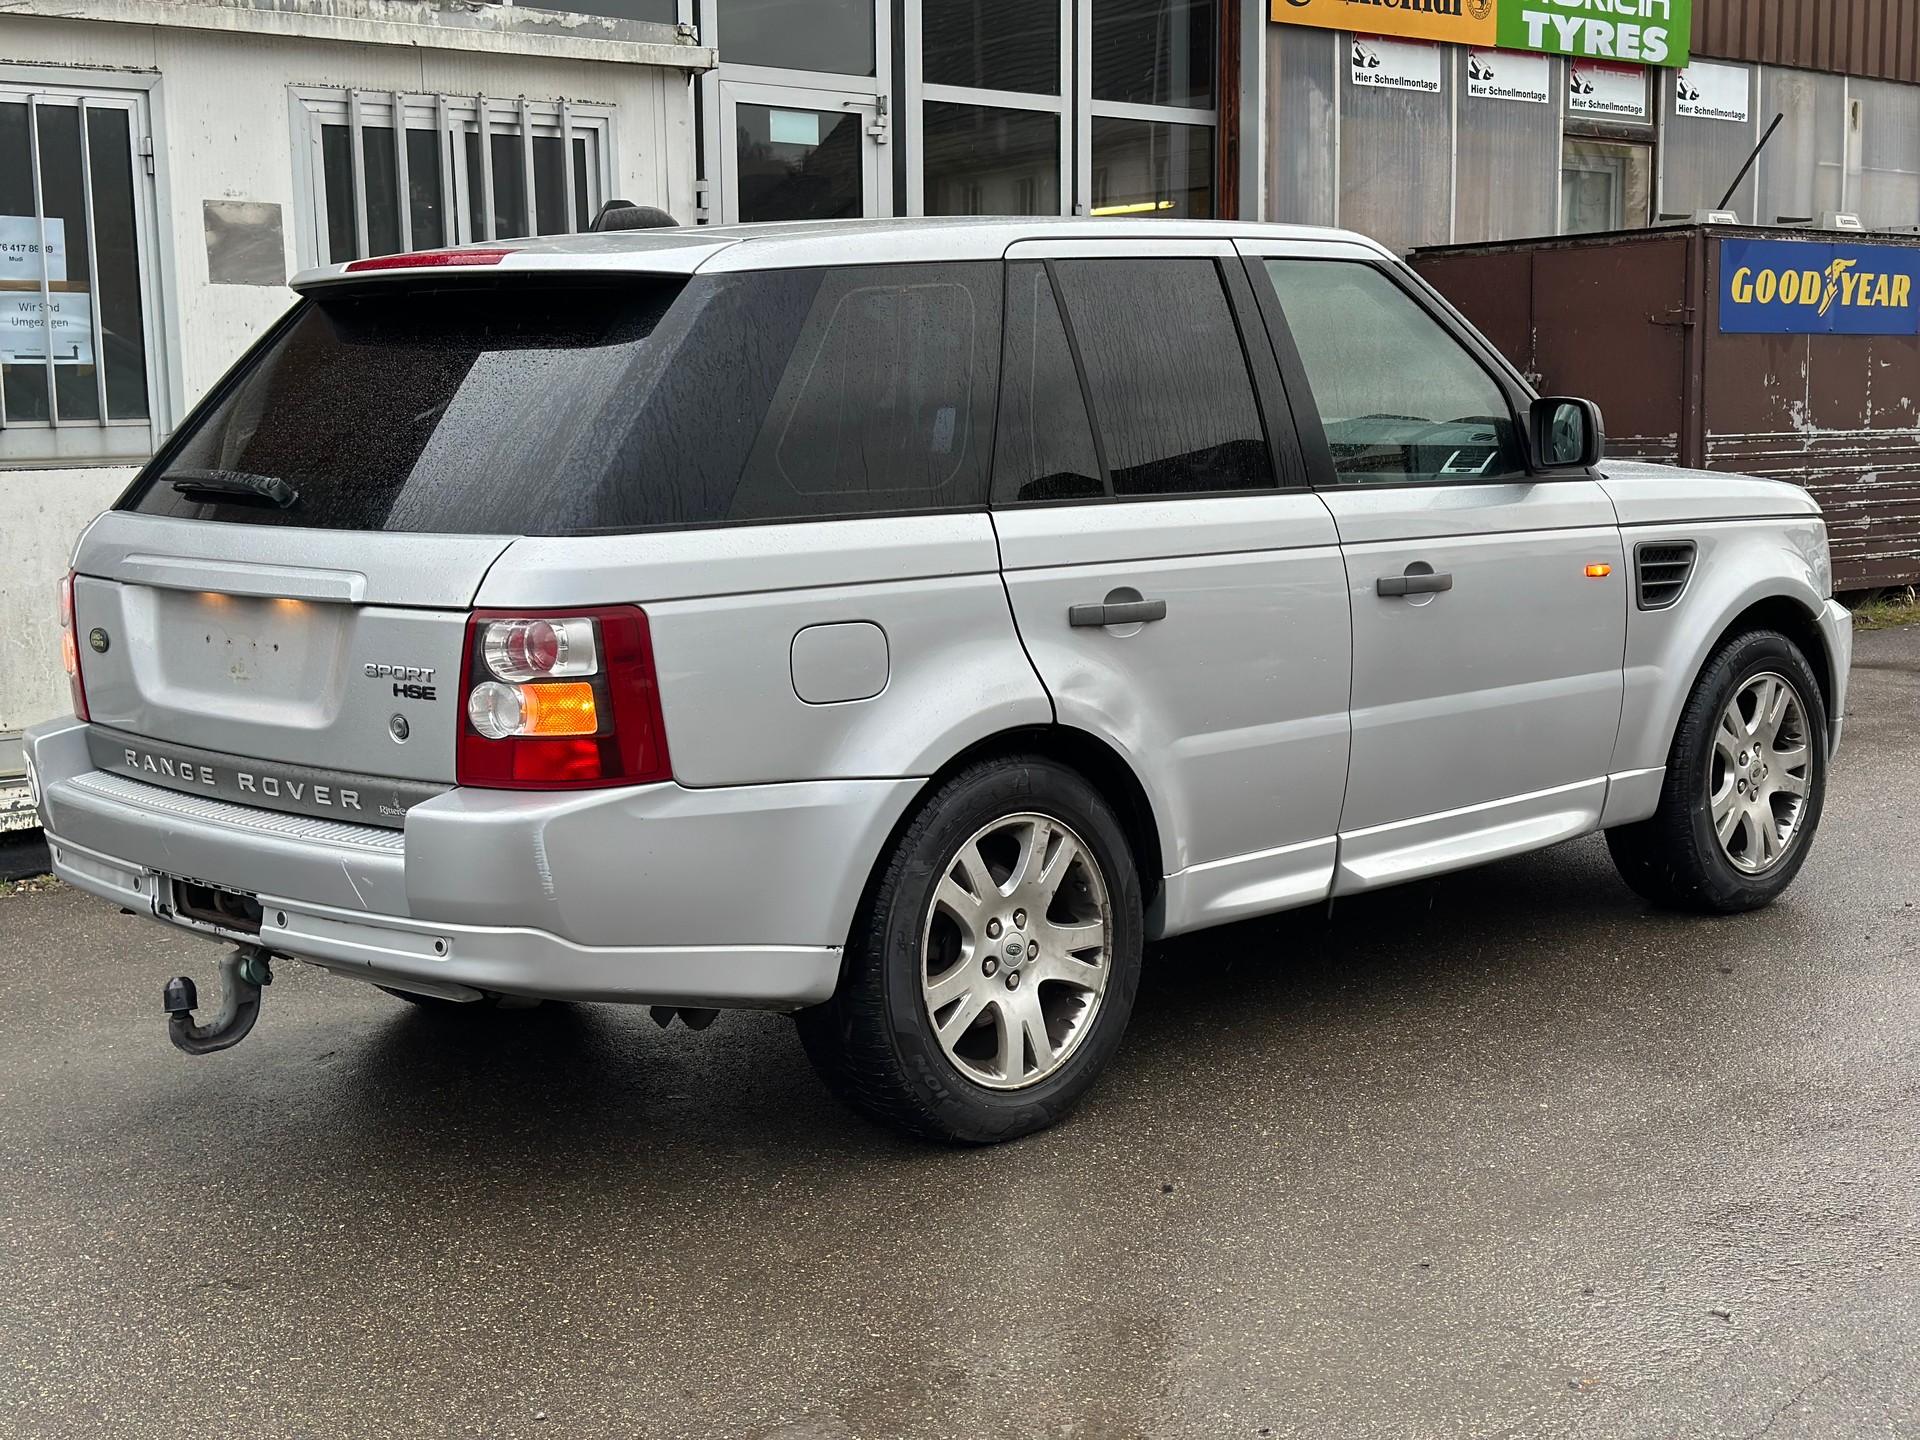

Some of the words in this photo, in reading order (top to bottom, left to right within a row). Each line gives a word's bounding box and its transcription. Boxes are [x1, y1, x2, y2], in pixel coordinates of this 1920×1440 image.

[1522, 10, 1669, 63] TYRES
[1355, 72, 1372, 83] Hier
[1374, 73, 1438, 91] Schnellmontage
[1471, 84, 1487, 95] Hier
[1488, 86, 1547, 101] Schnellmontage
[1572, 98, 1587, 108] Hier
[1588, 99, 1643, 115] Schnellmontage
[1678, 104, 1693, 113] Hier
[1694, 105, 1746, 120] Schnellmontage
[10, 244, 26, 253] 417
[18, 302, 37, 312] Wir
[38, 302, 60, 313] Snd
[11, 316, 69, 329] Umgezgen
[364, 662, 435, 683] SPORT
[393, 682, 437, 701] HSE
[124, 749, 216, 785] RANGE
[237, 772, 362, 810] ROVER
